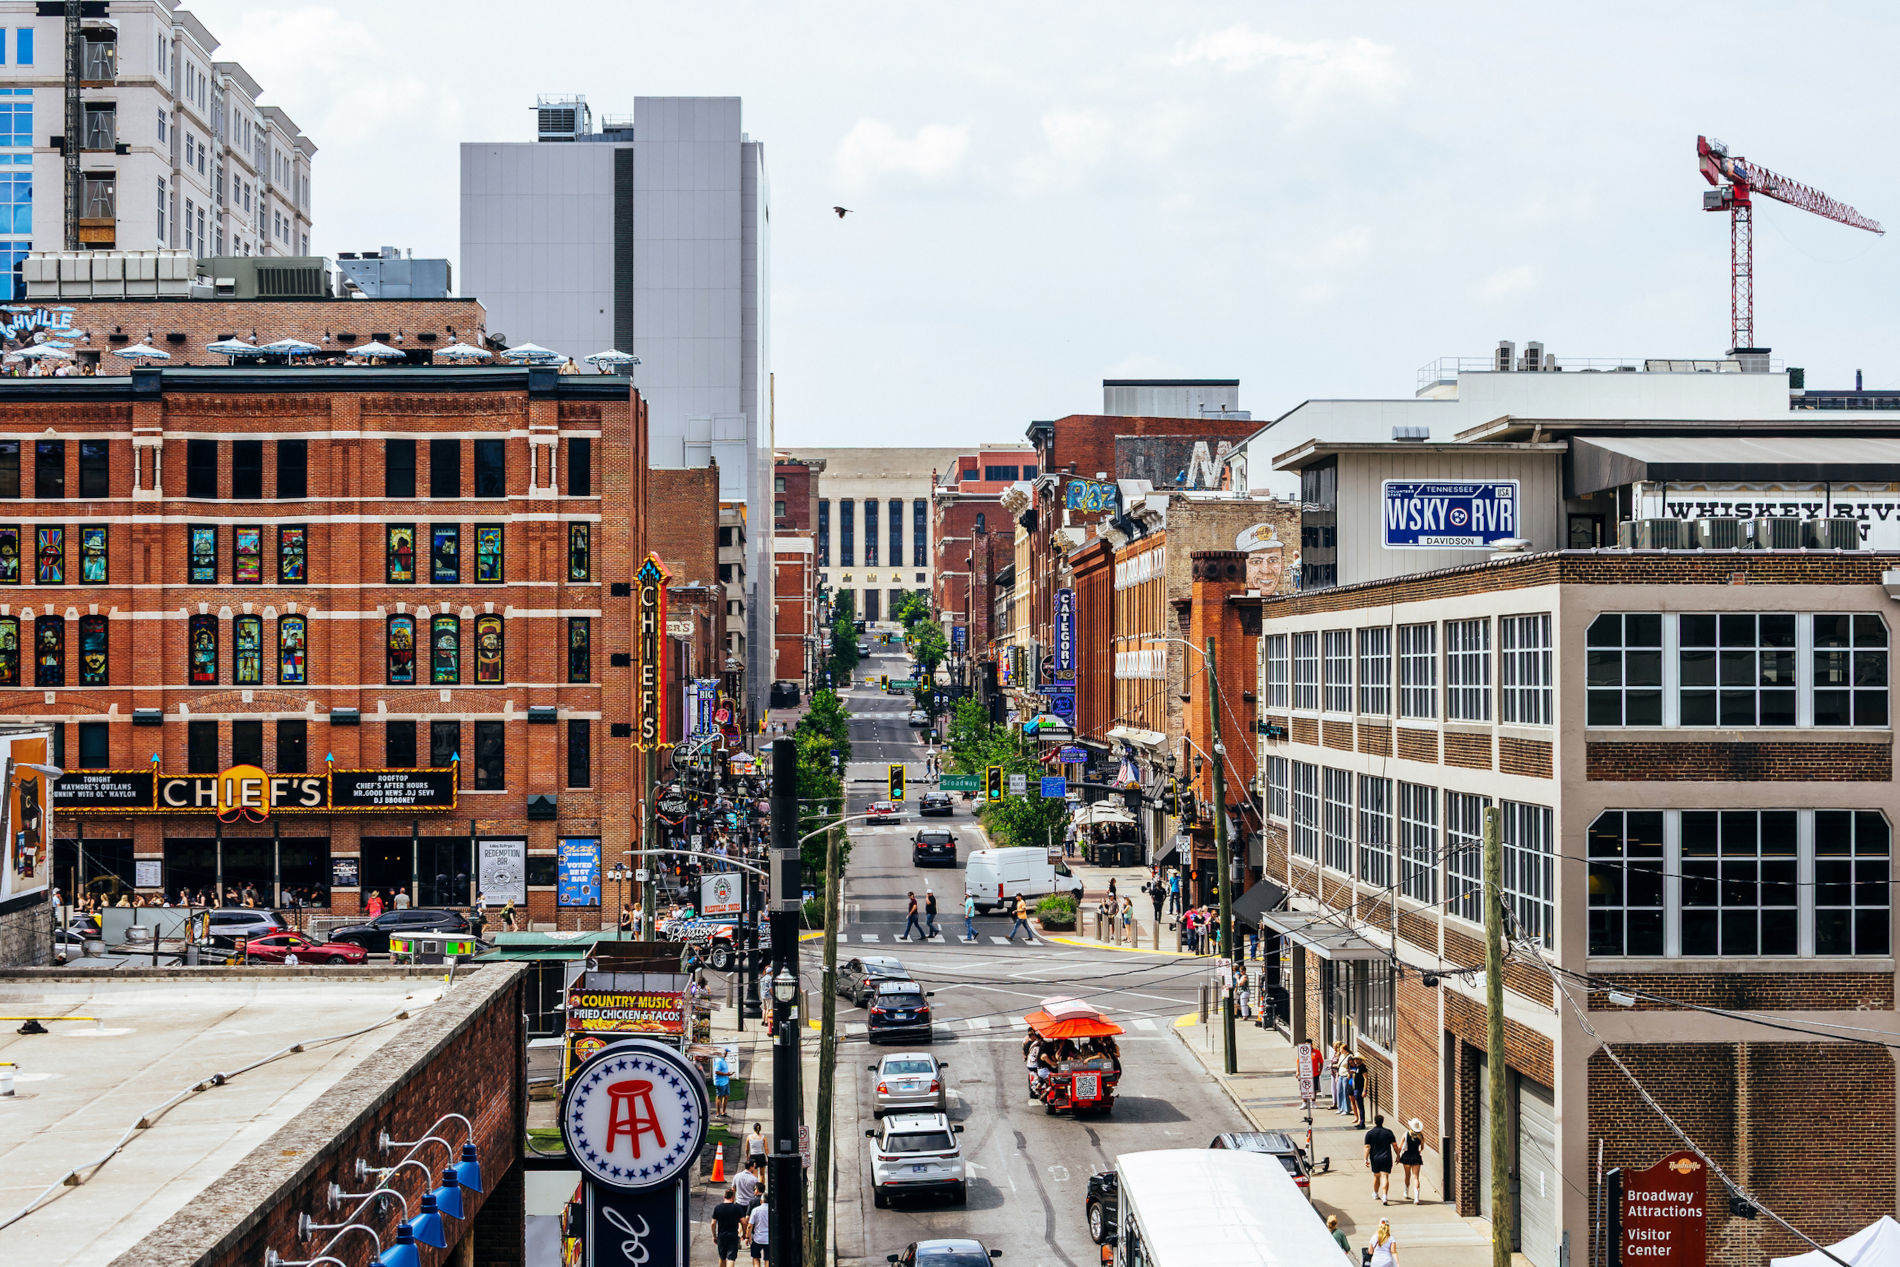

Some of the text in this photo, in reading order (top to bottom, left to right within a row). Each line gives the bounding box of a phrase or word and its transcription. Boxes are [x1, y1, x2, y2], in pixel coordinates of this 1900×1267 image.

[1497, 488, 1510, 497] USA
[1387, 498, 1513, 531] WSKY RVR
[1667, 502, 1823, 520] WHISKEY
[1426, 537, 1475, 545] DAVIDSON
[1060, 593, 1070, 669] CATEGORY
[641, 586, 655, 739] CHIEFS
[699, 691, 714, 700] BIG
[355, 782, 382, 790] CHIEF'S
[942, 779, 977, 787] Broadway
[163, 778, 322, 807] CHIEF'S
[484, 849, 520, 858] REDEMPTION
[569, 868, 590, 876] BEST
[571, 875, 588, 883] BAR
[666, 919, 720, 942] Barstool
[582, 995, 673, 1009] COUNTRY MUSIC
[574, 1009, 680, 1022] FRIED CHICKEN & TACOS
[1627, 1189, 1694, 1204] Broadway
[1627, 1205, 1703, 1217] Attractions
[1627, 1228, 1672, 1240] Visitor
[1627, 1244, 1672, 1256] Center
